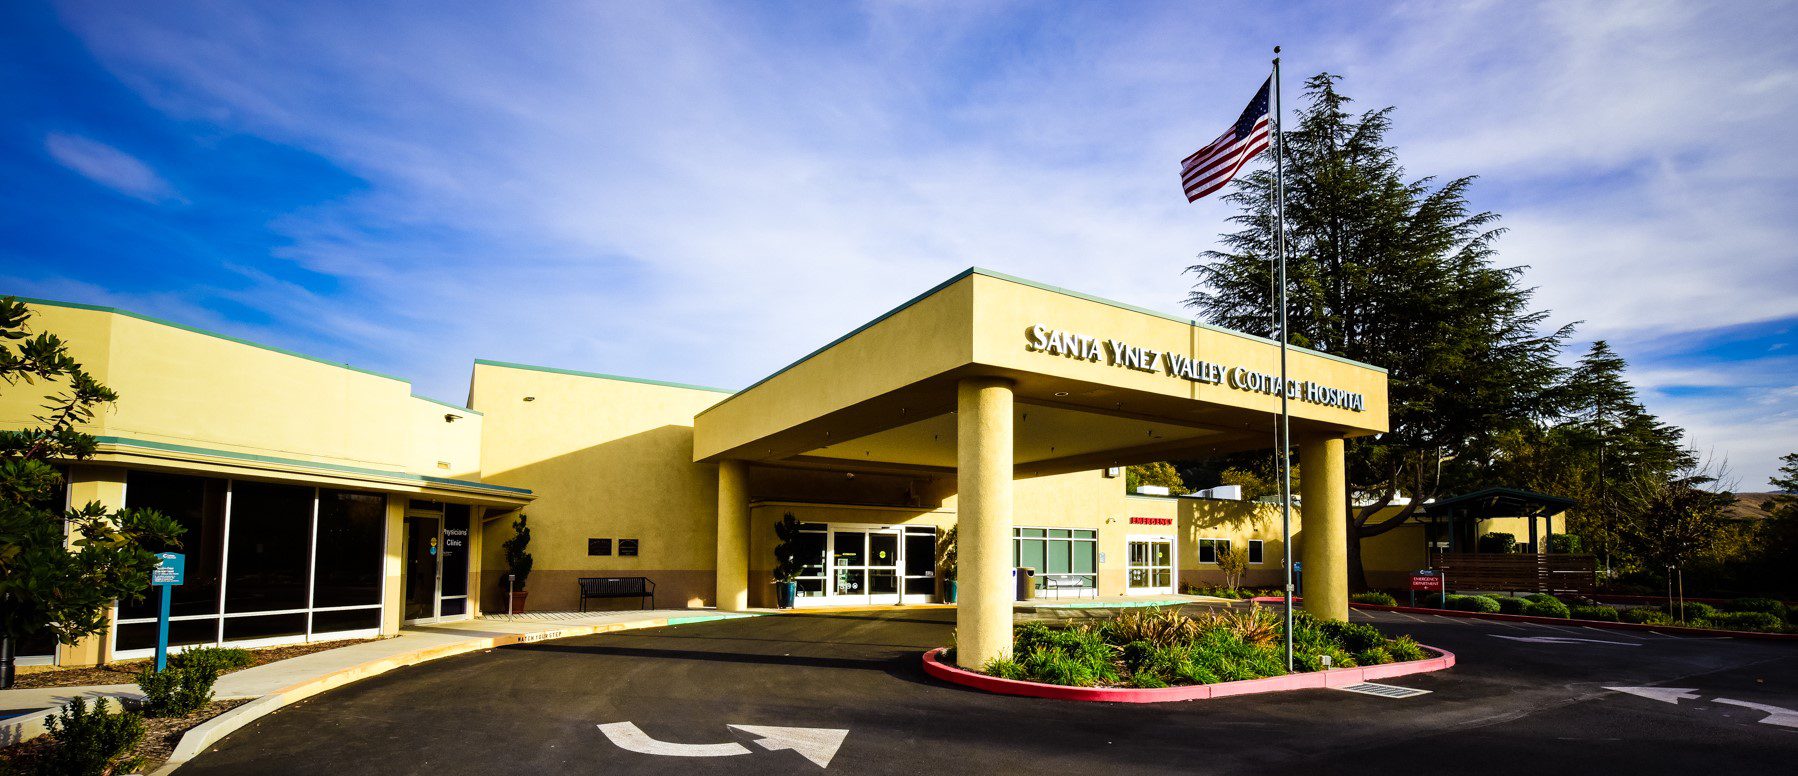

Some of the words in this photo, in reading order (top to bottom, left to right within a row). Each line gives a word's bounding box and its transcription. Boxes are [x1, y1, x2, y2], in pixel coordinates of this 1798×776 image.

[1032, 322, 1101, 361] SANTA
[1108, 339, 1161, 372] YNEZ
[1167, 351, 1227, 383] VALLEY
[1233, 365, 1302, 398] COTTAGE
[1307, 381, 1366, 411] HOSPITAL
[1129, 517, 1173, 526] EMERGENCY
[446, 538, 462, 546] Clinic
